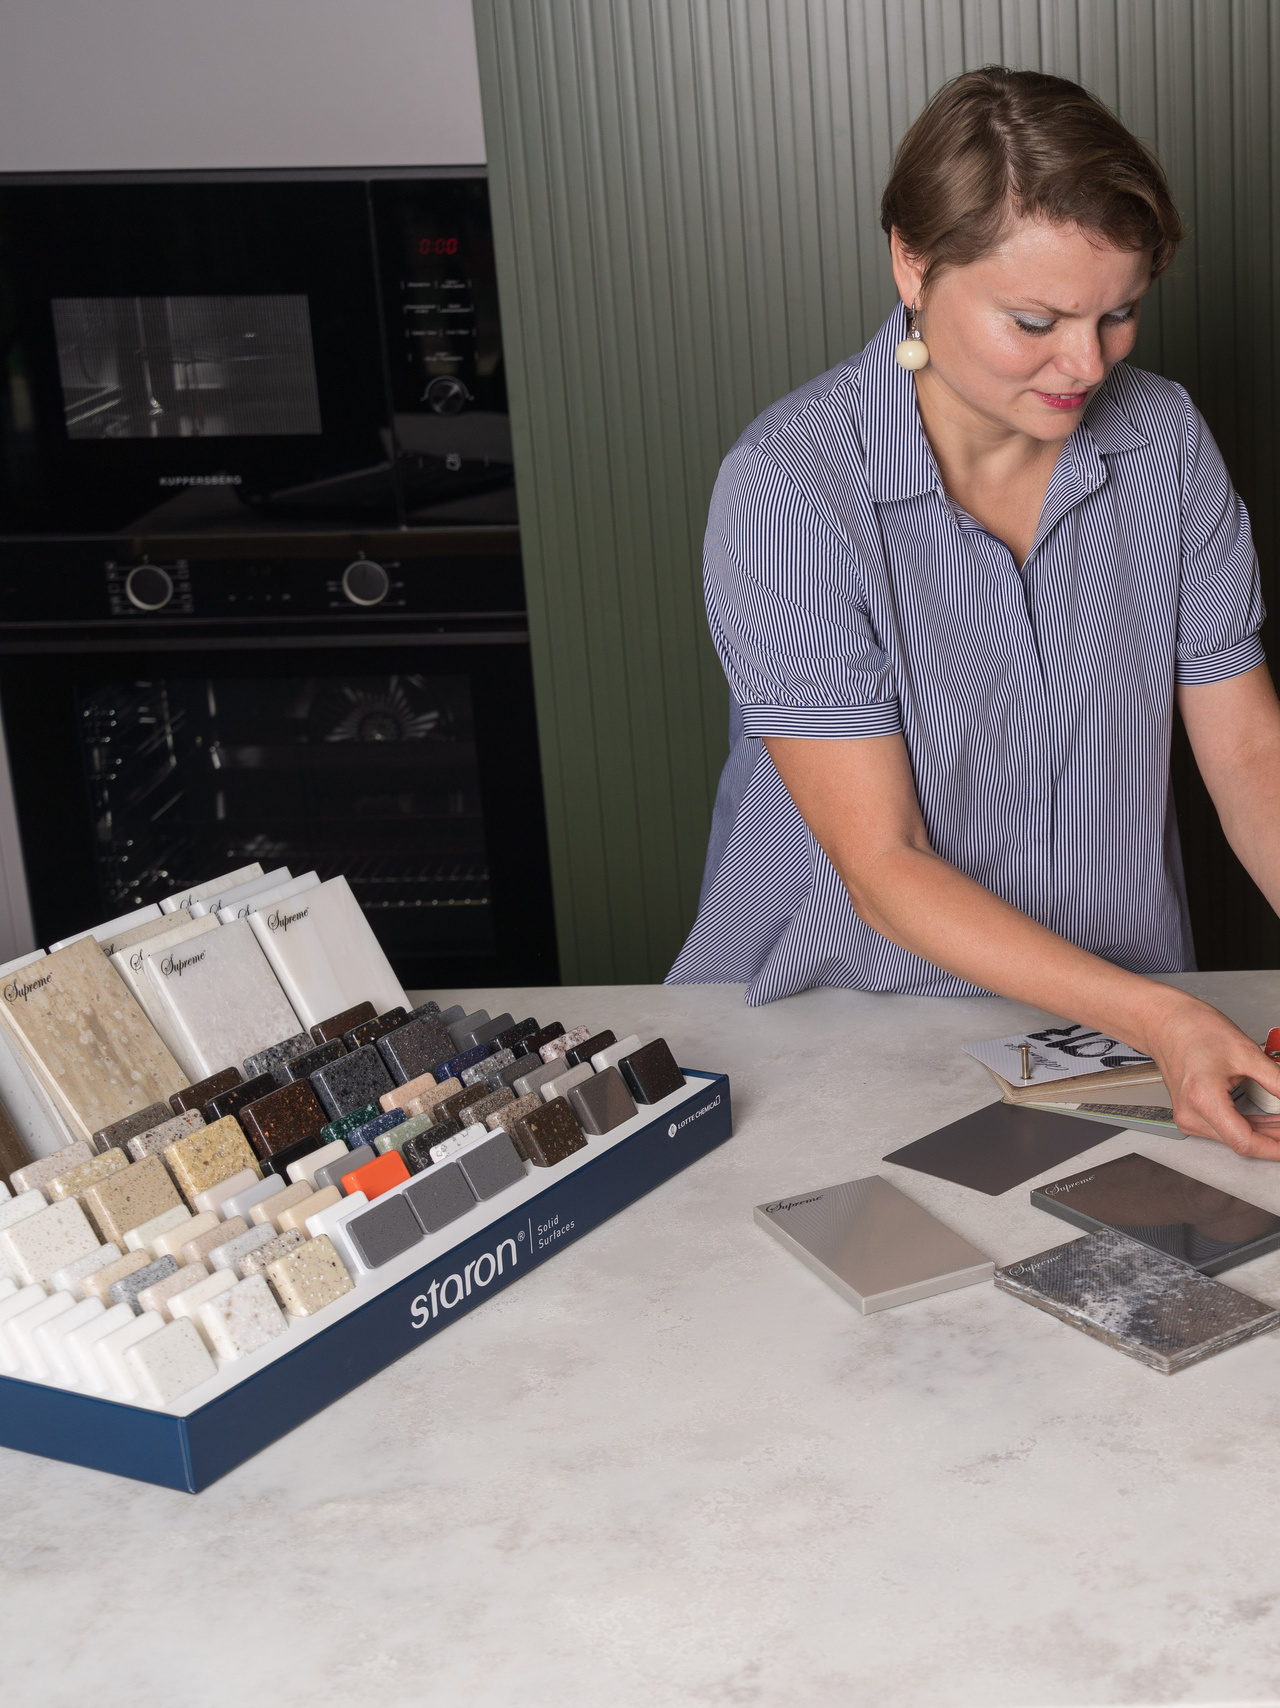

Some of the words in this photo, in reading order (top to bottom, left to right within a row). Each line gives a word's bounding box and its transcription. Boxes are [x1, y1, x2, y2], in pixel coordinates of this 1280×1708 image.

[267, 907, 309, 932] Supreme
[160, 951, 206, 979] Supreme
[4, 971, 53, 1005] Supreme
[1044, 1175, 1095, 1196] Supreme
[765, 1194, 824, 1214] Supreme
[537, 1214, 559, 1236] Solid
[538, 1220, 575, 1249] Surfaces
[1008, 1254, 1063, 1277] Supreme
